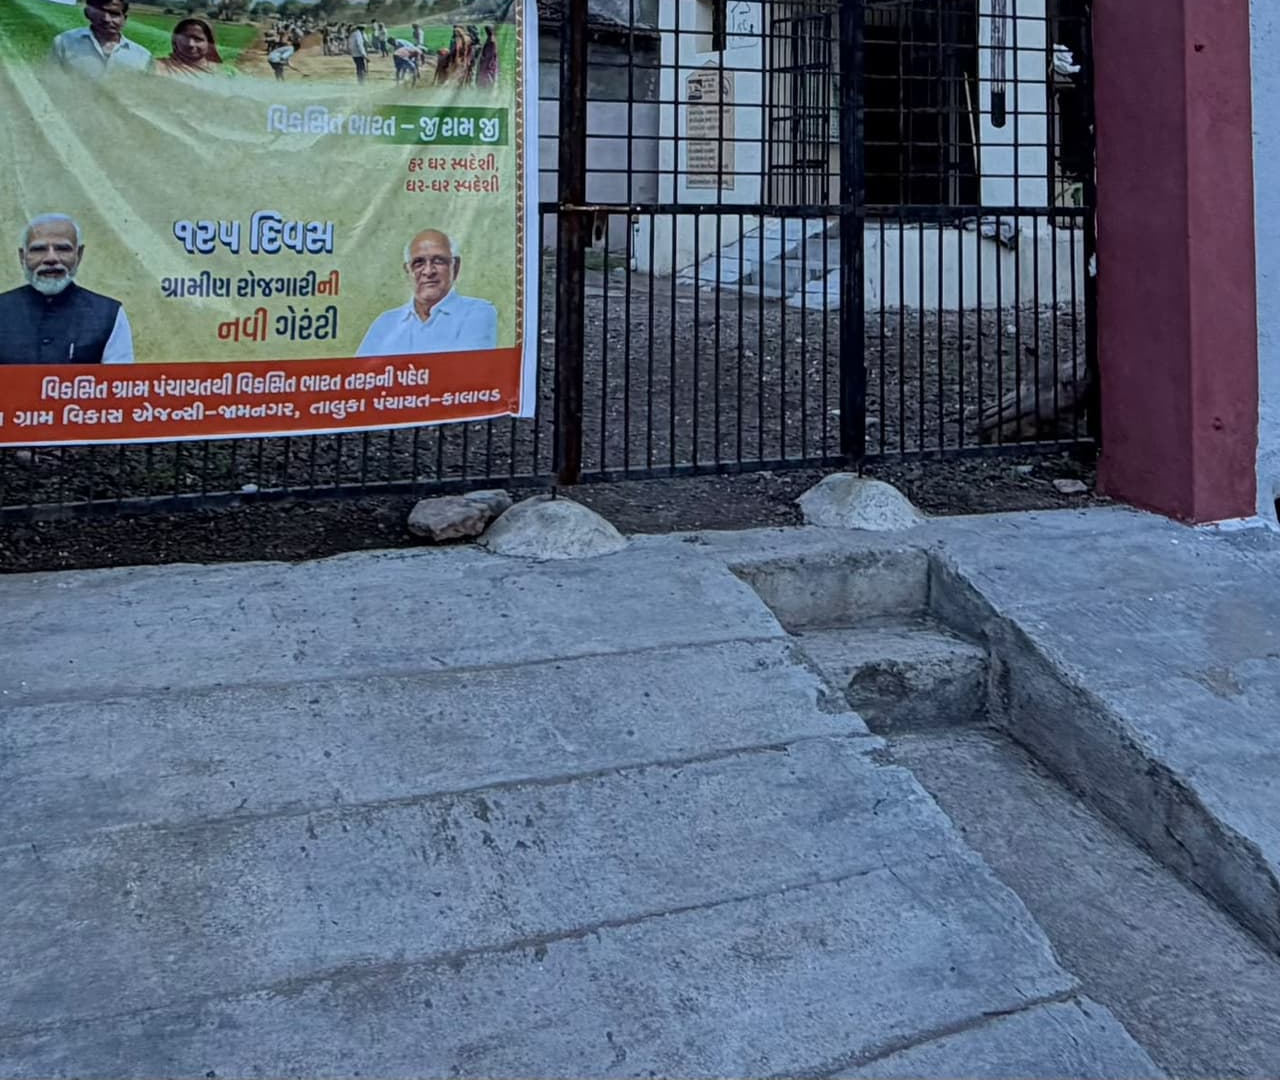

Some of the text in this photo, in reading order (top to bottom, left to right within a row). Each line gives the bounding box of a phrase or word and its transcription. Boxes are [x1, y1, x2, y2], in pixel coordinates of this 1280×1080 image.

[266, 104, 344, 134] વિકસિત
[347, 114, 396, 136] ભારત
[419, 116, 440, 142] જી
[442, 117, 474, 137] રામ
[479, 117, 500, 142] જી
[408, 157, 424, 172] હર
[428, 157, 446, 171] ઘર
[406, 175, 499, 193] ઘર-ઘર સ્વદેશી
[173, 209, 334, 254] ૧૨૫ દિવસ
[161, 270, 339, 297] ગ્રામીણ રોજગારીની
[217, 305, 338, 342] નવી ગેરંટી
[40, 363, 429, 400] વિકસિત ગ્રામ પંચાયતથી વિકસિત ભારત તરફની પહેલ
[13, 409, 53, 427] ગ્રામ
[62, 404, 123, 425] વિકાસ
[309, 398, 365, 419] તાલુકા
